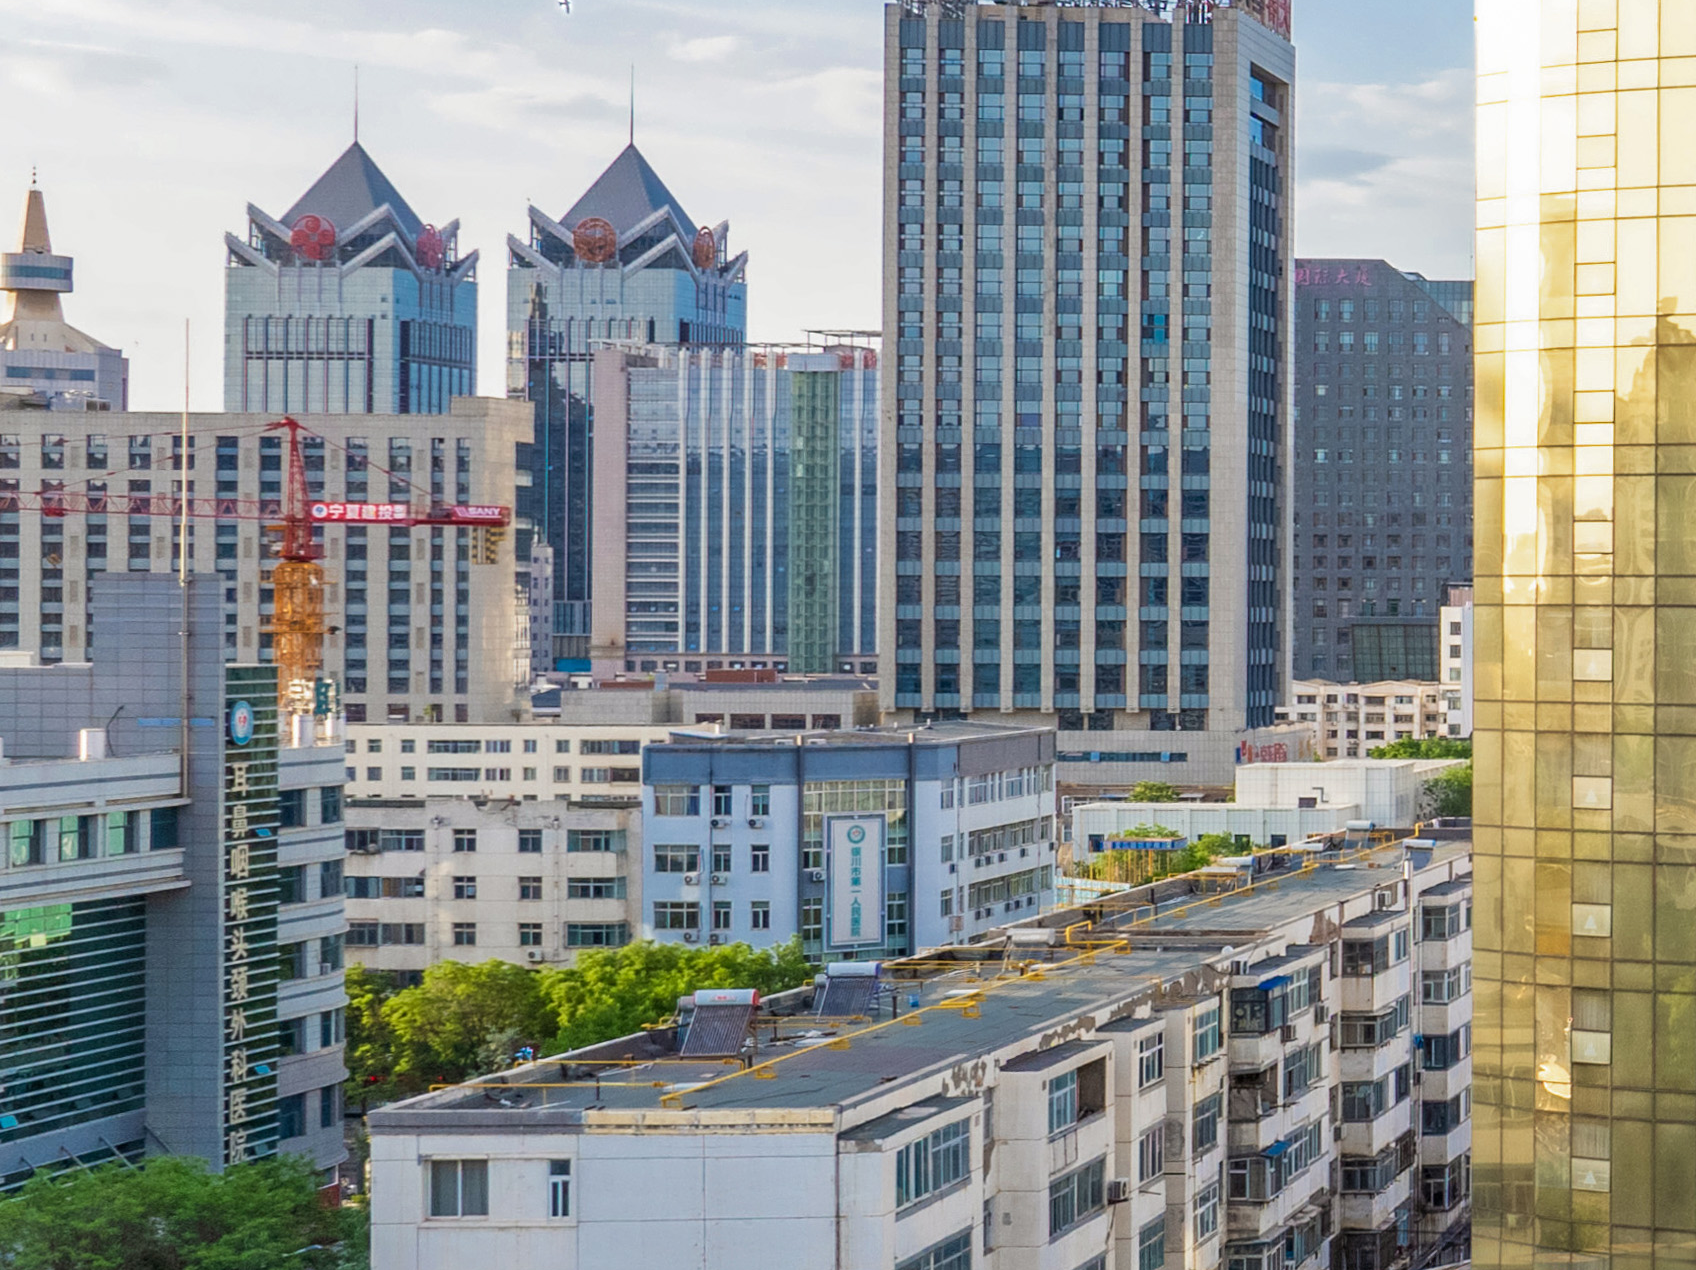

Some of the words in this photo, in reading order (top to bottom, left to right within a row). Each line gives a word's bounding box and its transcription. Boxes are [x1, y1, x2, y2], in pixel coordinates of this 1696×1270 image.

[230, 762, 249, 1166] 耳鼻咽喉头颈外科医院
